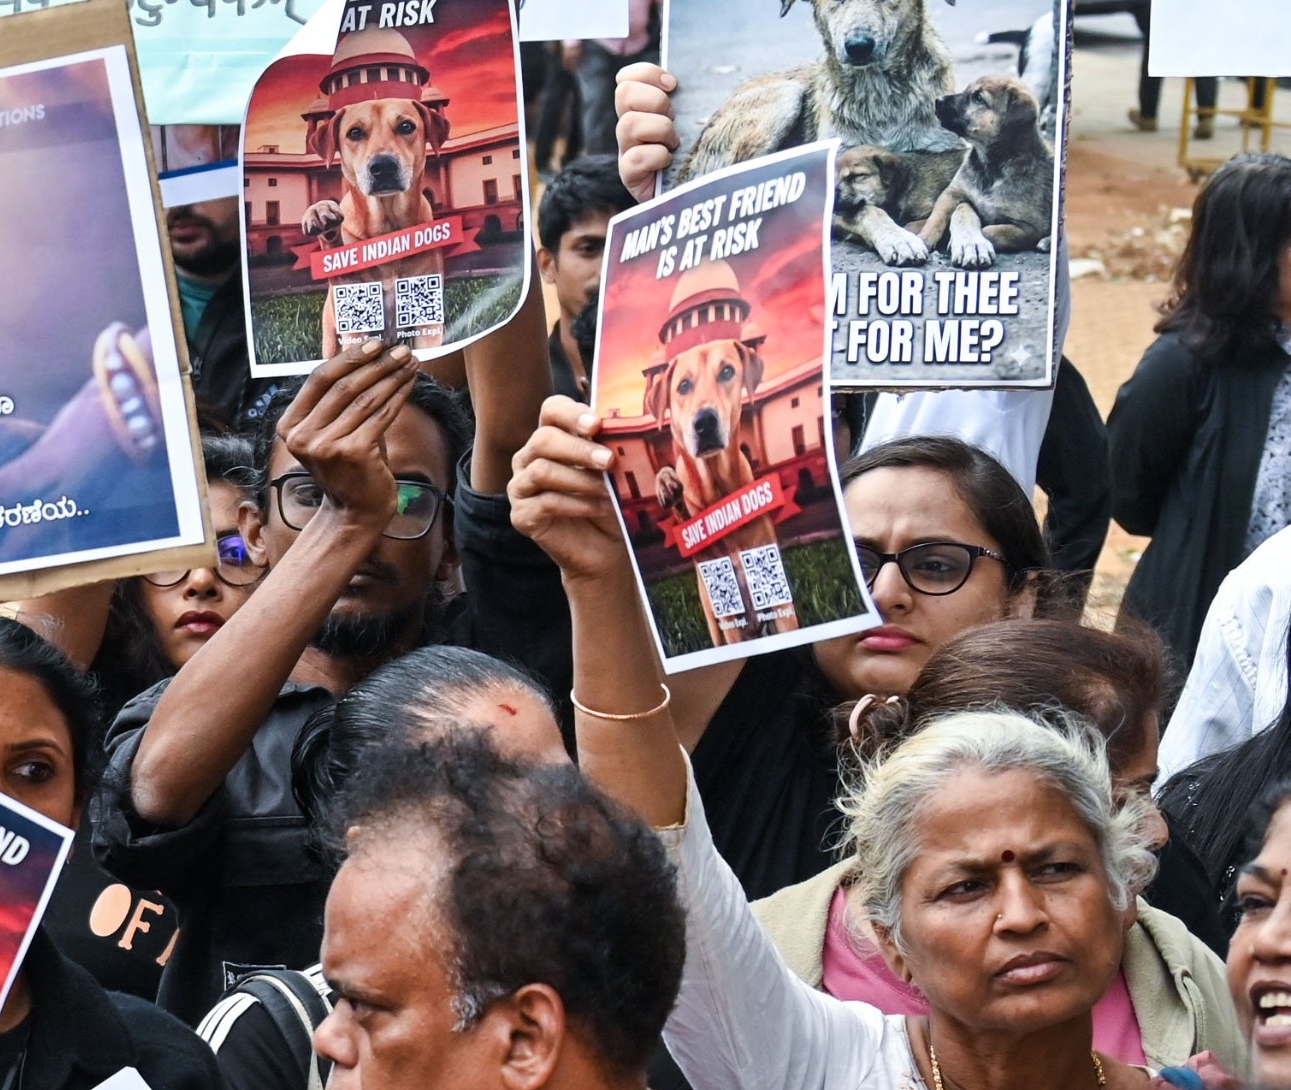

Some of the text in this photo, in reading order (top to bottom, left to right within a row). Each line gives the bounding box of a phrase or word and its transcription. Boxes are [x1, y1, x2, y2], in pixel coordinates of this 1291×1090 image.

[340, 5, 372, 33] AT
[378, 0, 437, 29] RISK
[620, 171, 806, 263] MAN'S BEST FRIEND
[323, 223, 451, 273] SAVE INDIAN DOGS
[656, 217, 763, 280] IS AT RISK
[858, 271, 925, 316] FOR
[934, 271, 1019, 316] THEE
[397, 327, 443, 338] Photo Expl.
[847, 319, 915, 363] FOR
[924, 319, 1004, 363] ME?
[682, 481, 774, 550] SAVE INDIAN DOGS
